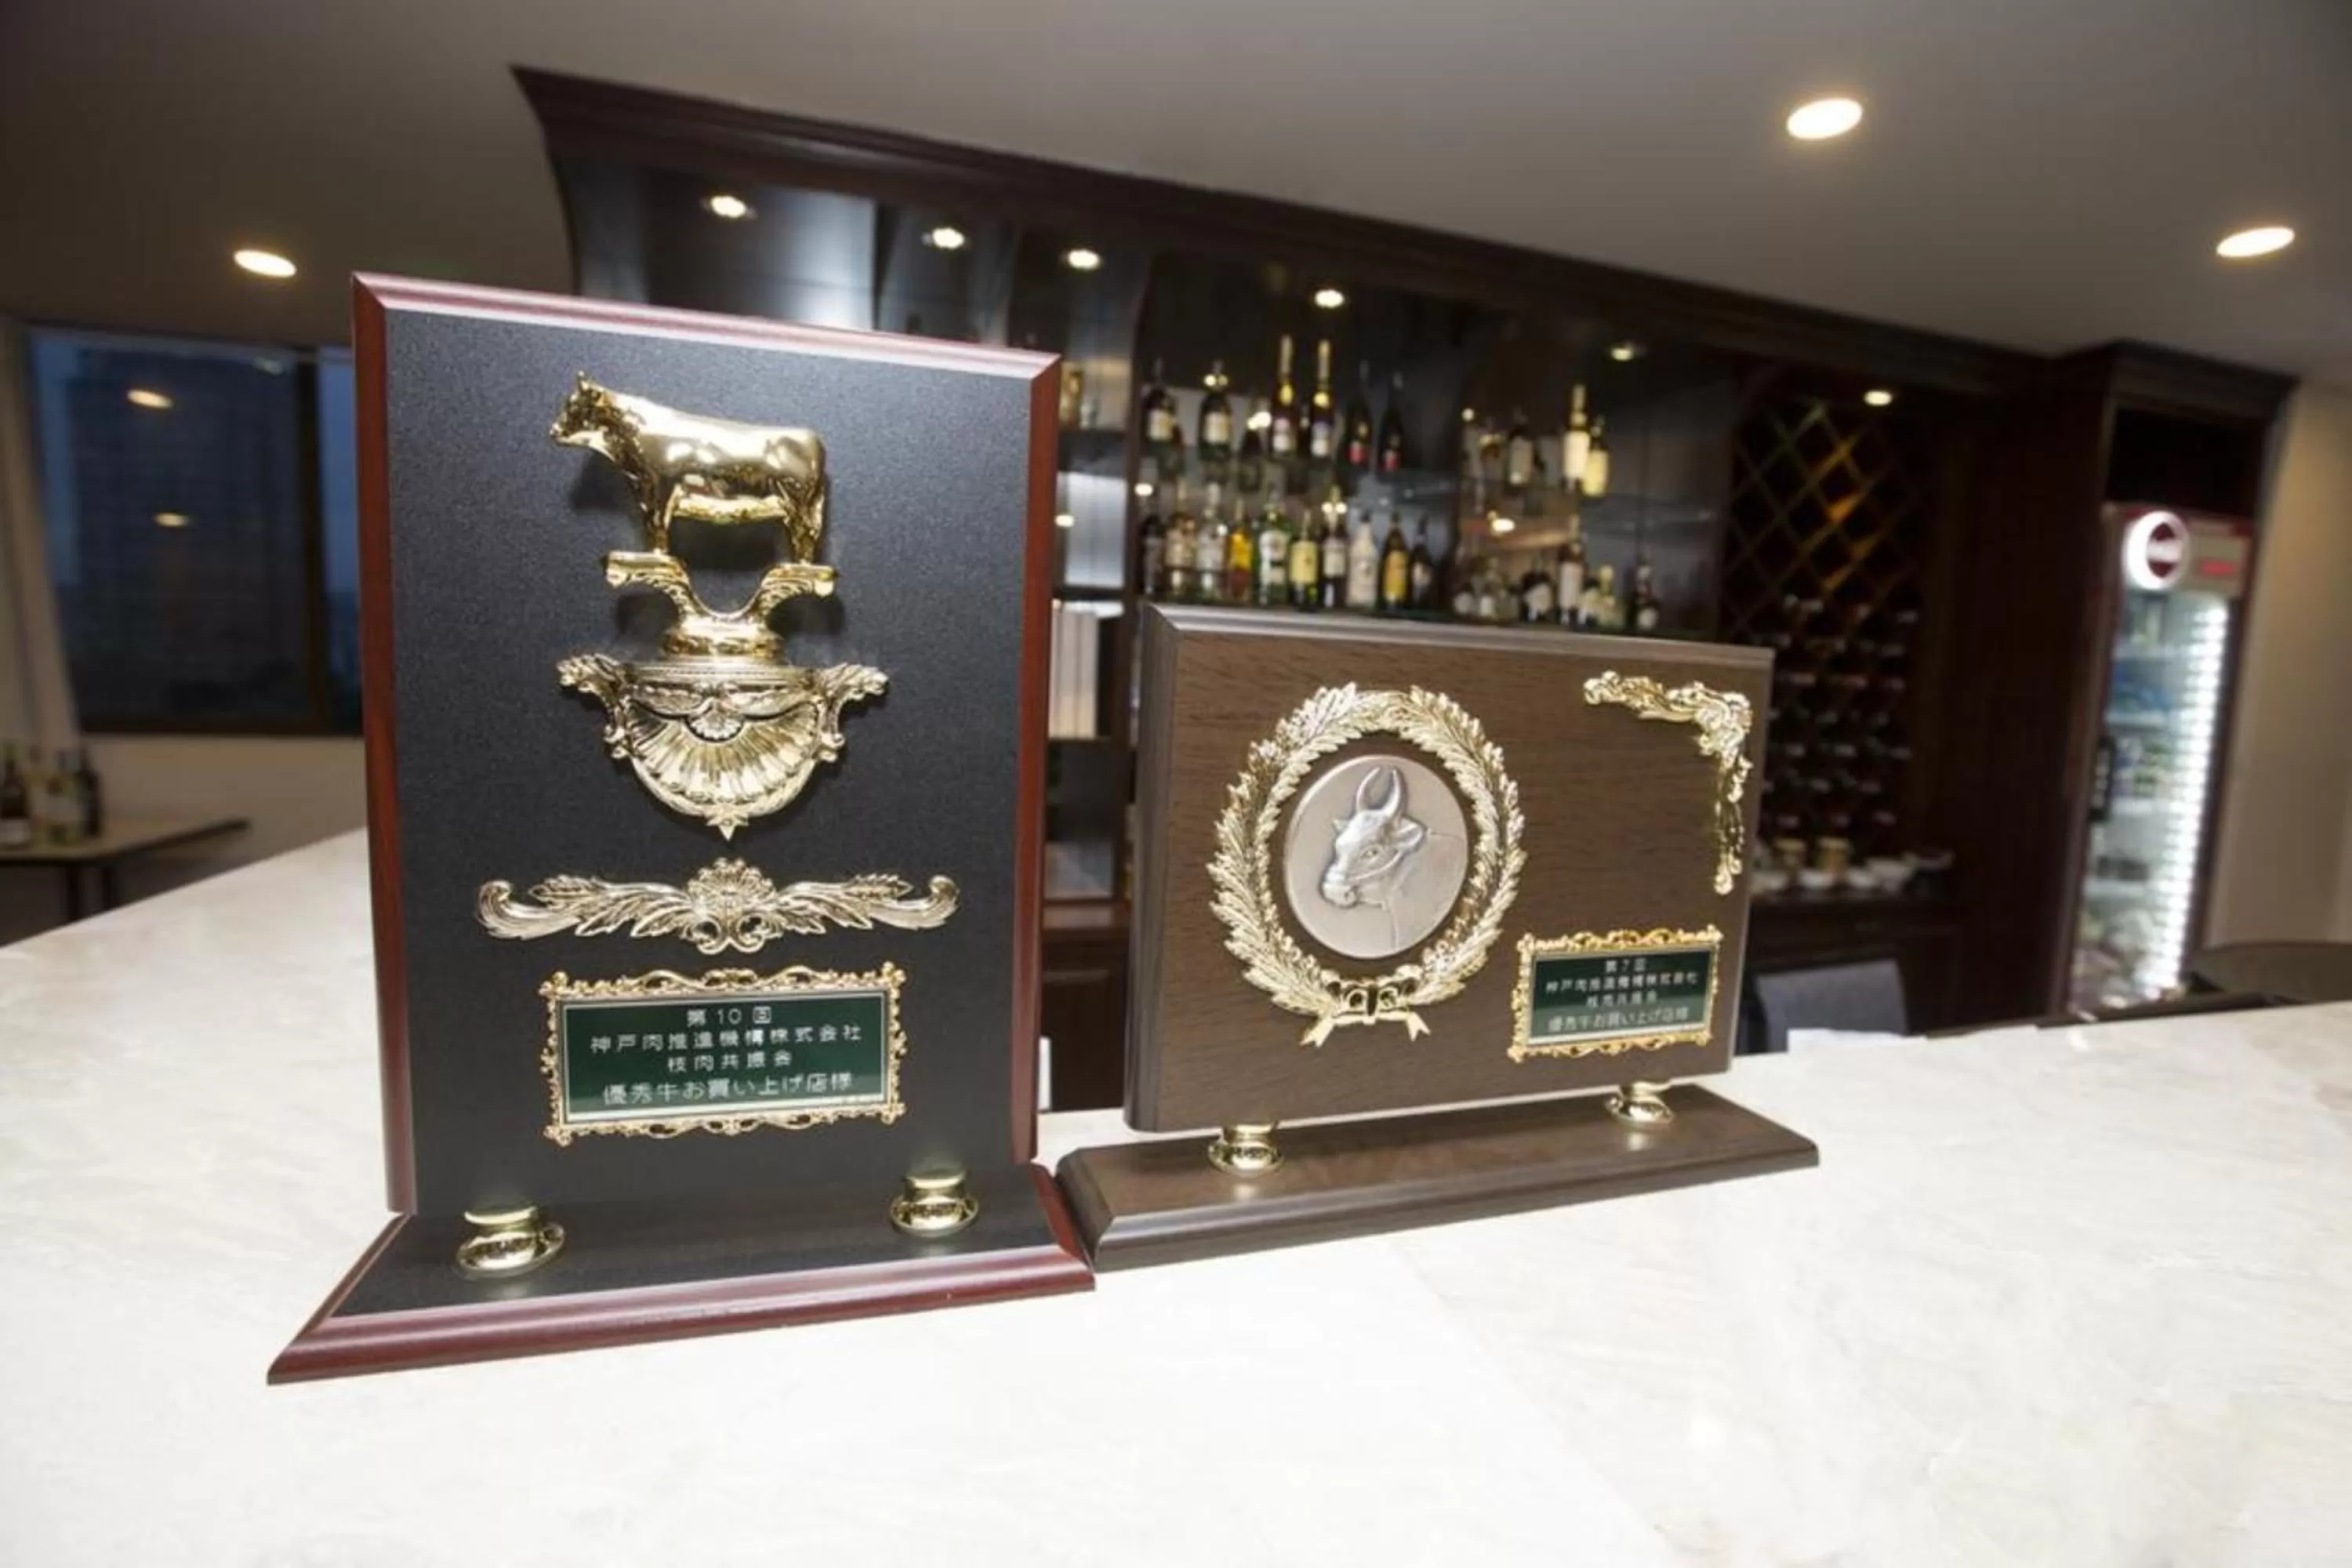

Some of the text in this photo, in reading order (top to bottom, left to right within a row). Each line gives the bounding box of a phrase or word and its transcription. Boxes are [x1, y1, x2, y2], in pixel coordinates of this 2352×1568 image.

[603, 1072, 854, 1106] 優秀牛お買い上げ店様
